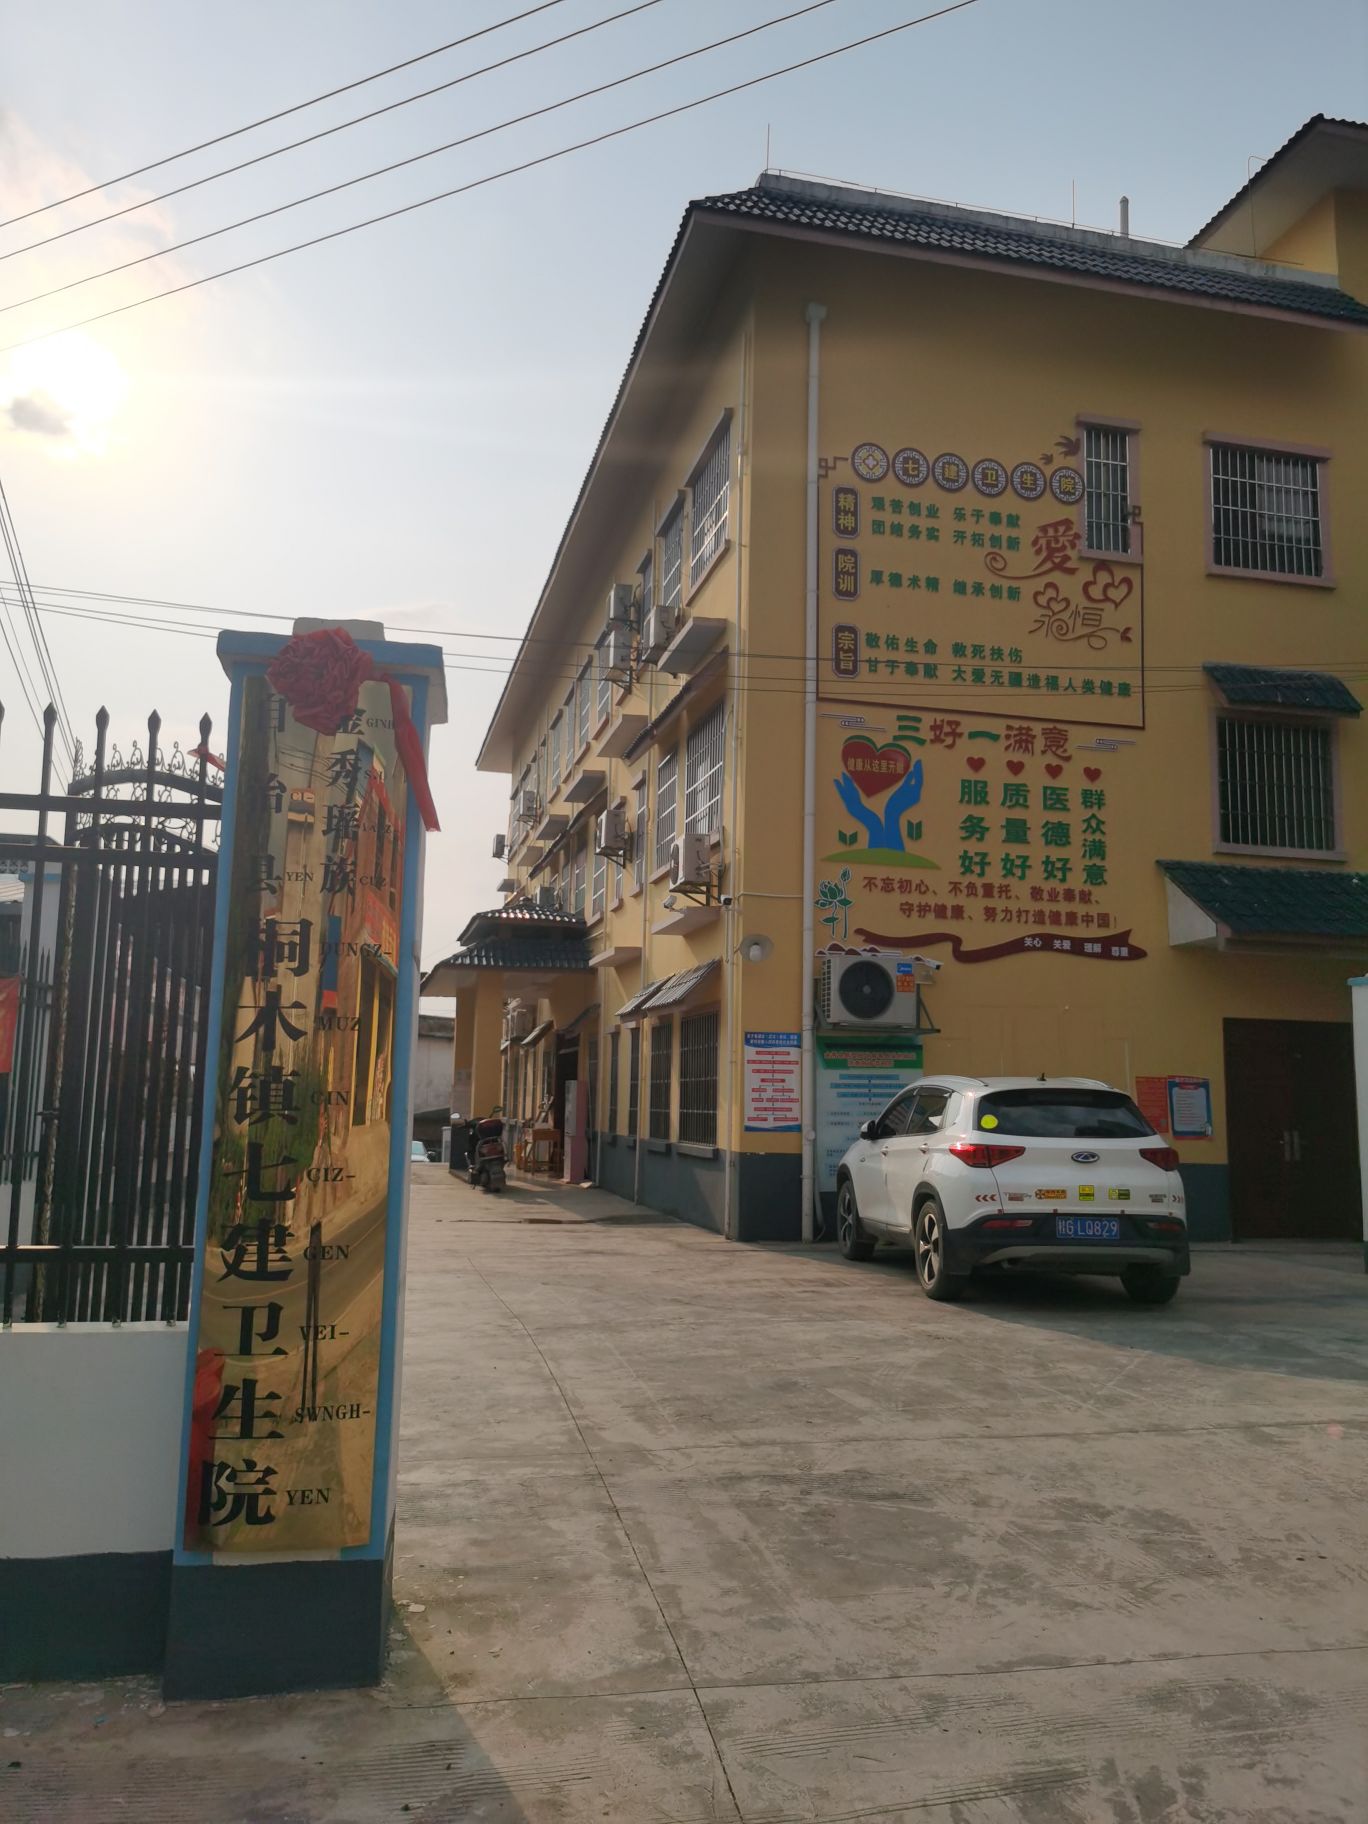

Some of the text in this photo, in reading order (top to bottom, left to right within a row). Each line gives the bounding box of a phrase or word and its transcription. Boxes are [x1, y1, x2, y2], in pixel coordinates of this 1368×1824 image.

[902, 458, 1078, 495] 七建卫生院
[836, 492, 857, 533] 精神
[953, 507, 1022, 530] 乐于奉献
[871, 519, 1022, 553] 团结务实 开拓创新
[837, 553, 857, 593] 院训
[953, 579, 1022, 603] 继承创新
[837, 631, 857, 672] 宗旨
[864, 631, 1024, 664] 敬佑生命 救死扶伤
[865, 656, 940, 681] 甘于奉献
[892, 713, 1073, 762] 三好一满意
[958, 778, 991, 879] 服务好
[1000, 782, 1032, 883] 质量好
[1041, 785, 1074, 886] 医德好
[1080, 788, 1109, 887] 群众满意
[1023, 936, 1043, 948] 关心
[285, 1486, 333, 1507] YEN
